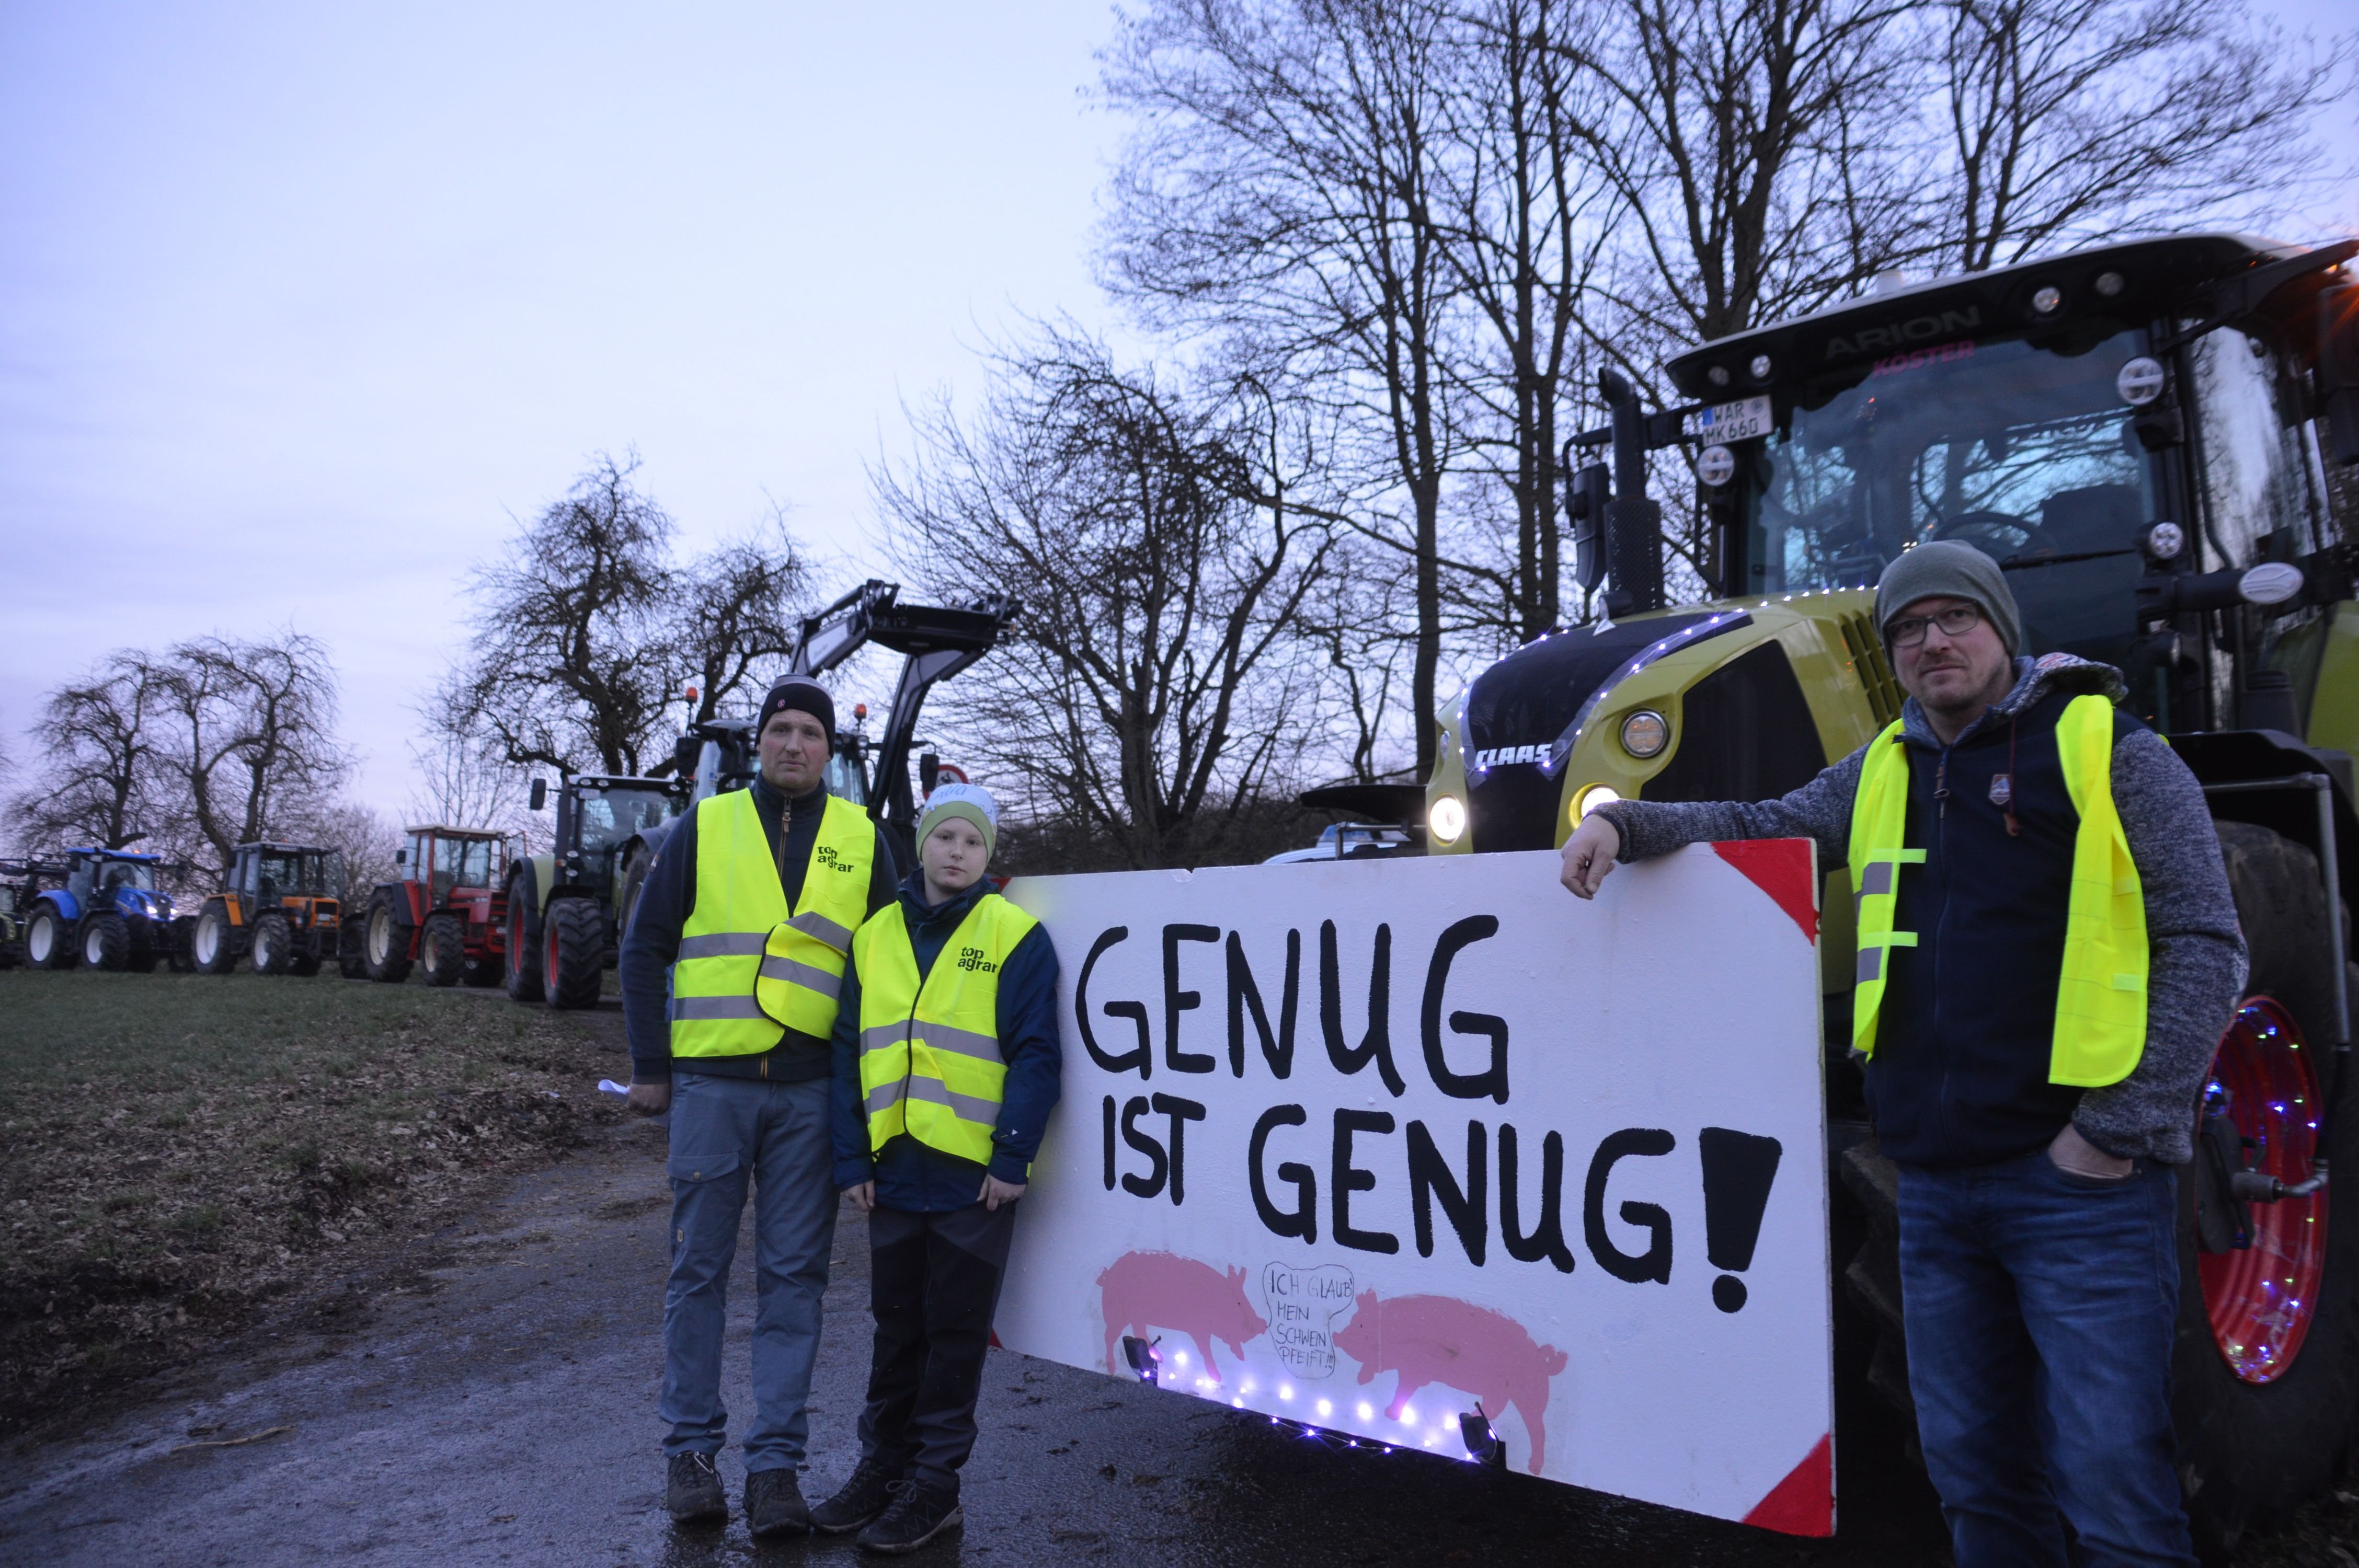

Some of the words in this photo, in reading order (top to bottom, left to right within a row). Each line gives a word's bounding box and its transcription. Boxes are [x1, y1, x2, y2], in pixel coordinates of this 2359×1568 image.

[1825, 305, 1981, 359] ARION
[1872, 340, 1975, 378] KÖSTER
[1714, 401, 1745, 423] WAR
[1474, 744, 1552, 768] CLAAS
[817, 846, 838, 860] top
[817, 855, 854, 873] agrar
[958, 958, 997, 973] agrar
[961, 947, 984, 960] top
[1075, 915, 1510, 1105] GENUG
[1103, 1091, 1206, 1206] IST
[1248, 1103, 1782, 1313] GENUG!
[1272, 1270, 1299, 1296] ICH
[1278, 1301, 1309, 1320] MEIN
[1276, 1323, 1326, 1347] SCHWEIN
